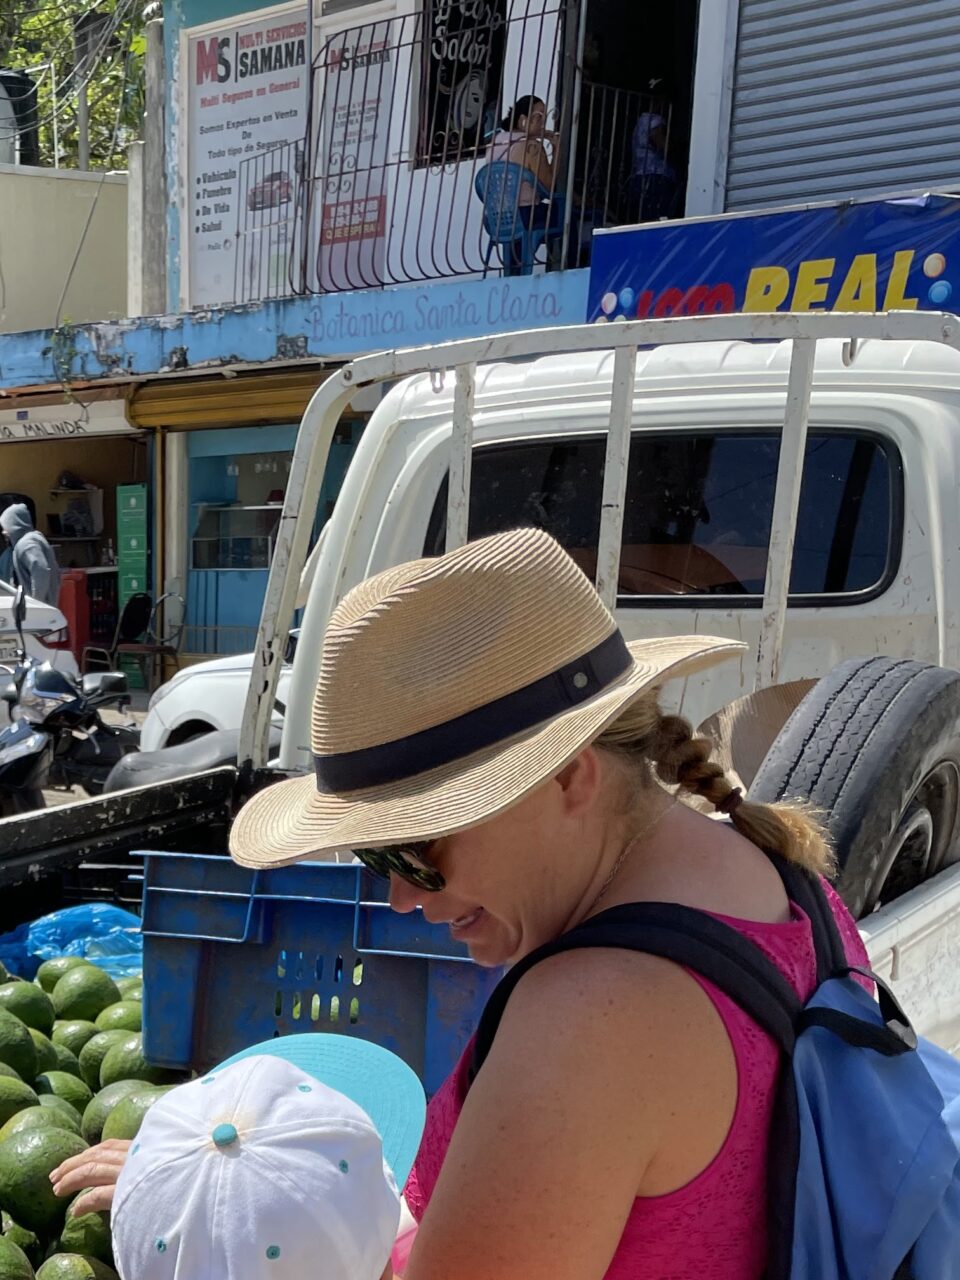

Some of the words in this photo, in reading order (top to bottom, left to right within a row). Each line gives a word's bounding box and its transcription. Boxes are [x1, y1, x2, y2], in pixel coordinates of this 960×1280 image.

[196, 36, 231, 85] MS
[239, 38, 306, 78] SAMANA
[226, 116, 260, 130] Expertos
[262, 113, 273, 122] en
[274, 109, 298, 120] Venta
[241, 131, 252, 140] De
[208, 149, 225, 159] Todo
[742, 250, 919, 313] REAL
[414, 291, 482, 333] Santa
[487, 284, 562, 326] Clara
